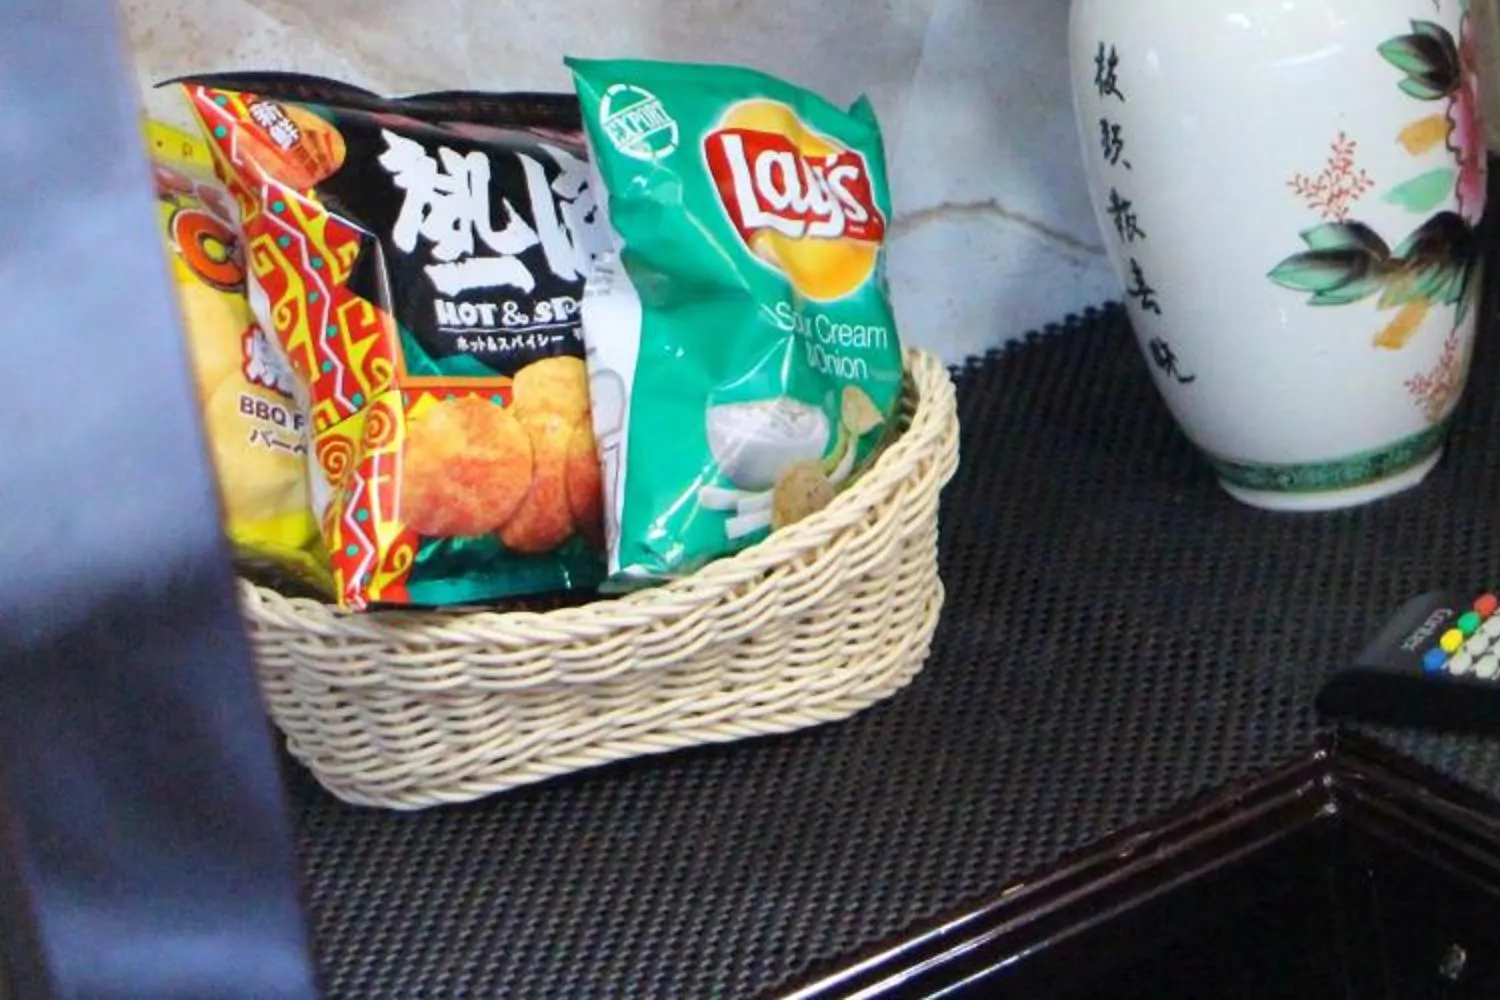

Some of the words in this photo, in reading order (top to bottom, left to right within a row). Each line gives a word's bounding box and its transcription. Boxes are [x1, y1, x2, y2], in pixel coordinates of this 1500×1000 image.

[719, 133, 869, 238] Lay's
[434, 299, 497, 326] HOT
[502, 301, 529, 325] &
[533, 296, 583, 322] SP
[815, 313, 888, 351] Cream
[240, 395, 287, 428] BBQ
[293, 412, 304, 431] F
